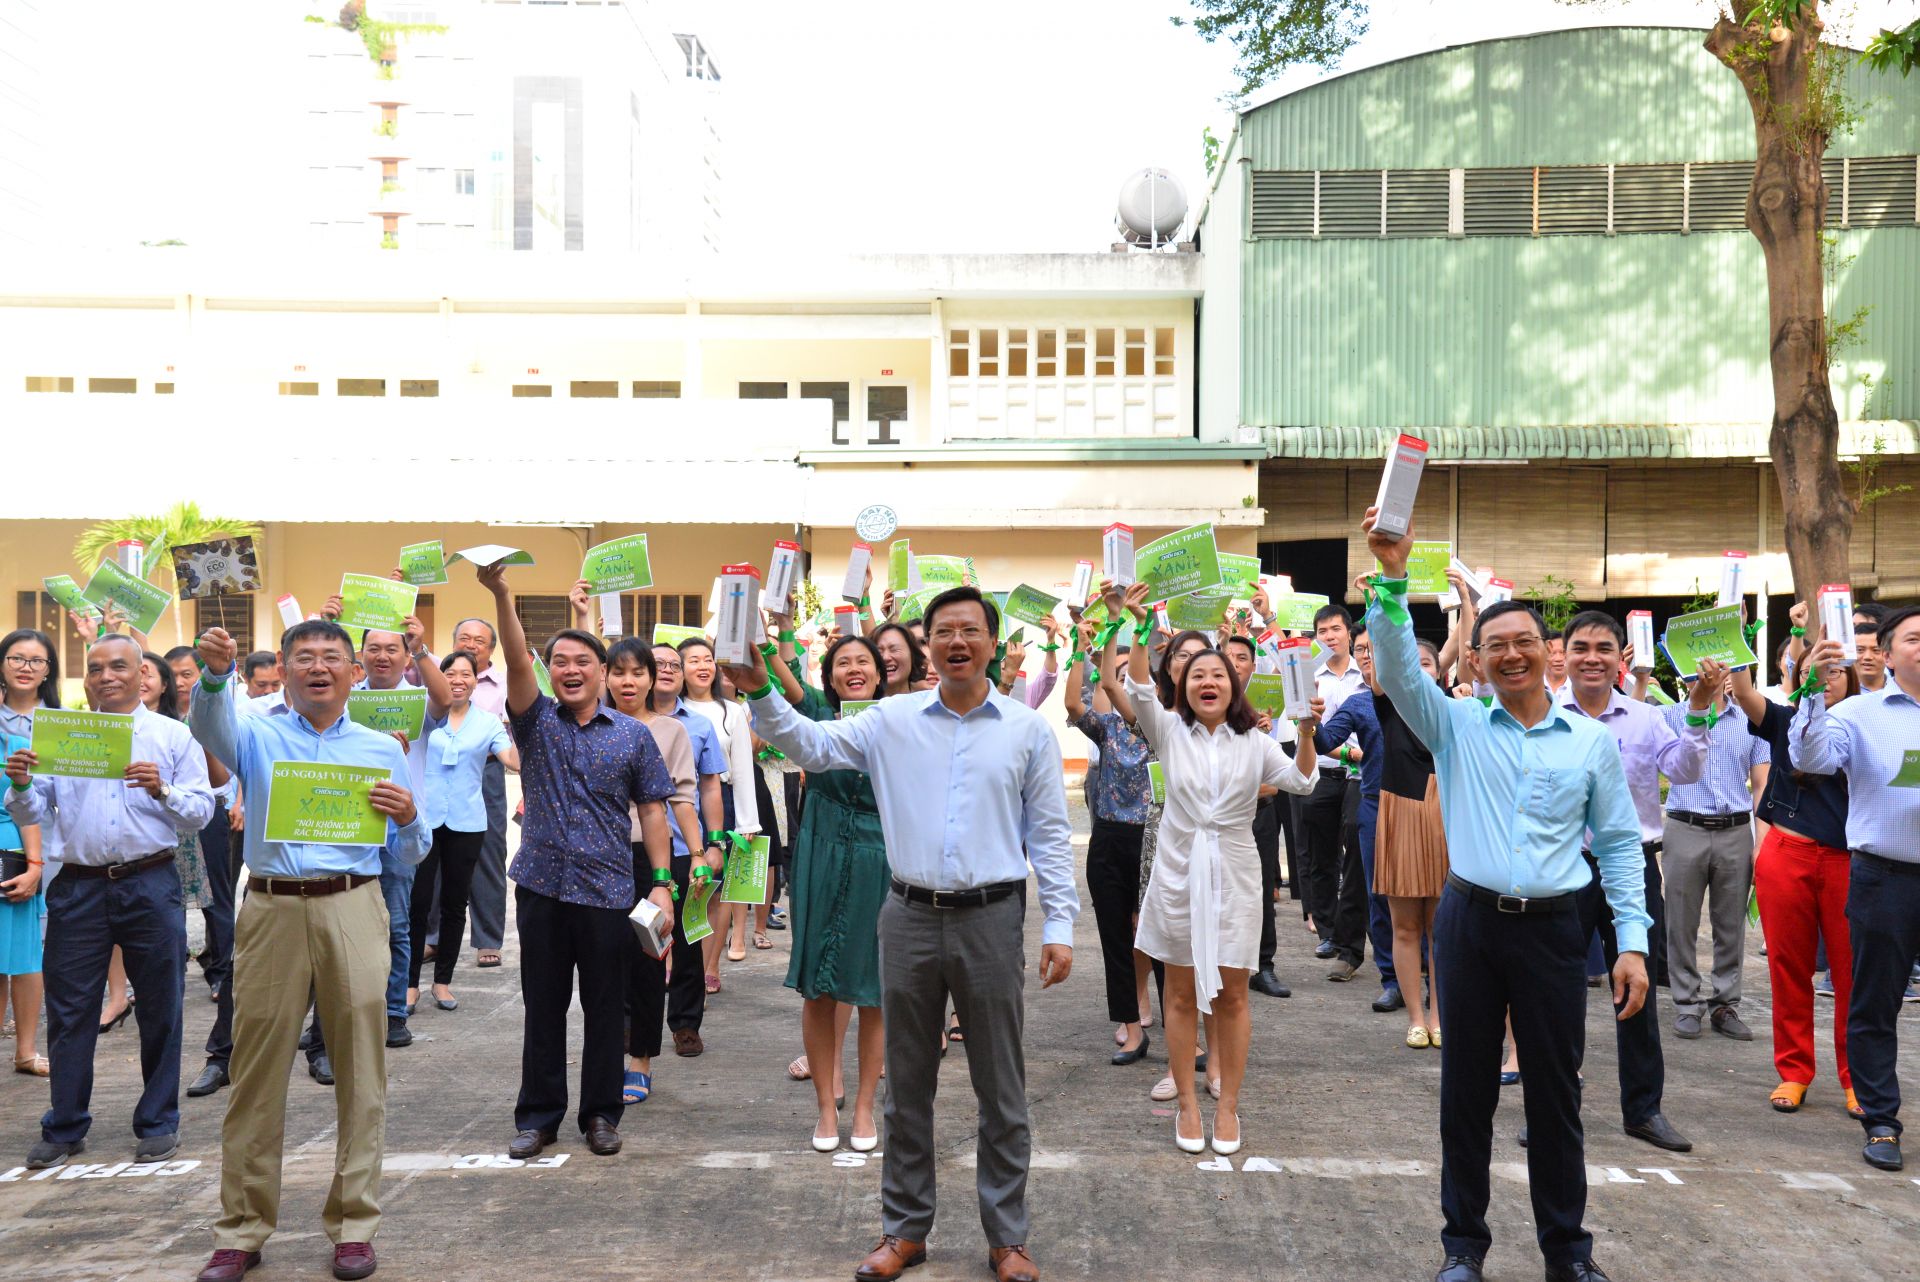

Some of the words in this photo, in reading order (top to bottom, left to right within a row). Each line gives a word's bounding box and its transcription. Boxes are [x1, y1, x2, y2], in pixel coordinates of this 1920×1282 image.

[861, 507, 881, 520] SAY
[884, 509, 895, 524] NO
[1170, 538, 1180, 547] VỤ
[206, 561, 225, 573] ECO
[1680, 618, 1703, 628] NGOẠI
[1703, 616, 1713, 625] VỤ
[361, 695, 386, 703] NGOẠI
[388, 695, 399, 703] VỤ
[35, 714, 48, 723] SỞ
[50, 716, 80, 727] NGOẠI
[83, 718, 97, 728] VỤ
[98, 719, 134, 729] TP.HCM
[70, 759, 96, 767] KHÔNG
[97, 760, 110, 768] VỚI
[1904, 755, 1918, 764] SỞ
[274, 768, 290, 778] SỞ
[291, 770, 328, 782] NGOẠI
[331, 772, 346, 784] VỤ
[315, 820, 344, 829] KHÔNG
[345, 821, 361, 830] VỚI
[294, 829, 311, 837] RÁC
[331, 831, 359, 840] NHỰA"
[1196, 1156, 1283, 1172] VP
[1606, 1167, 1685, 1185] LT
